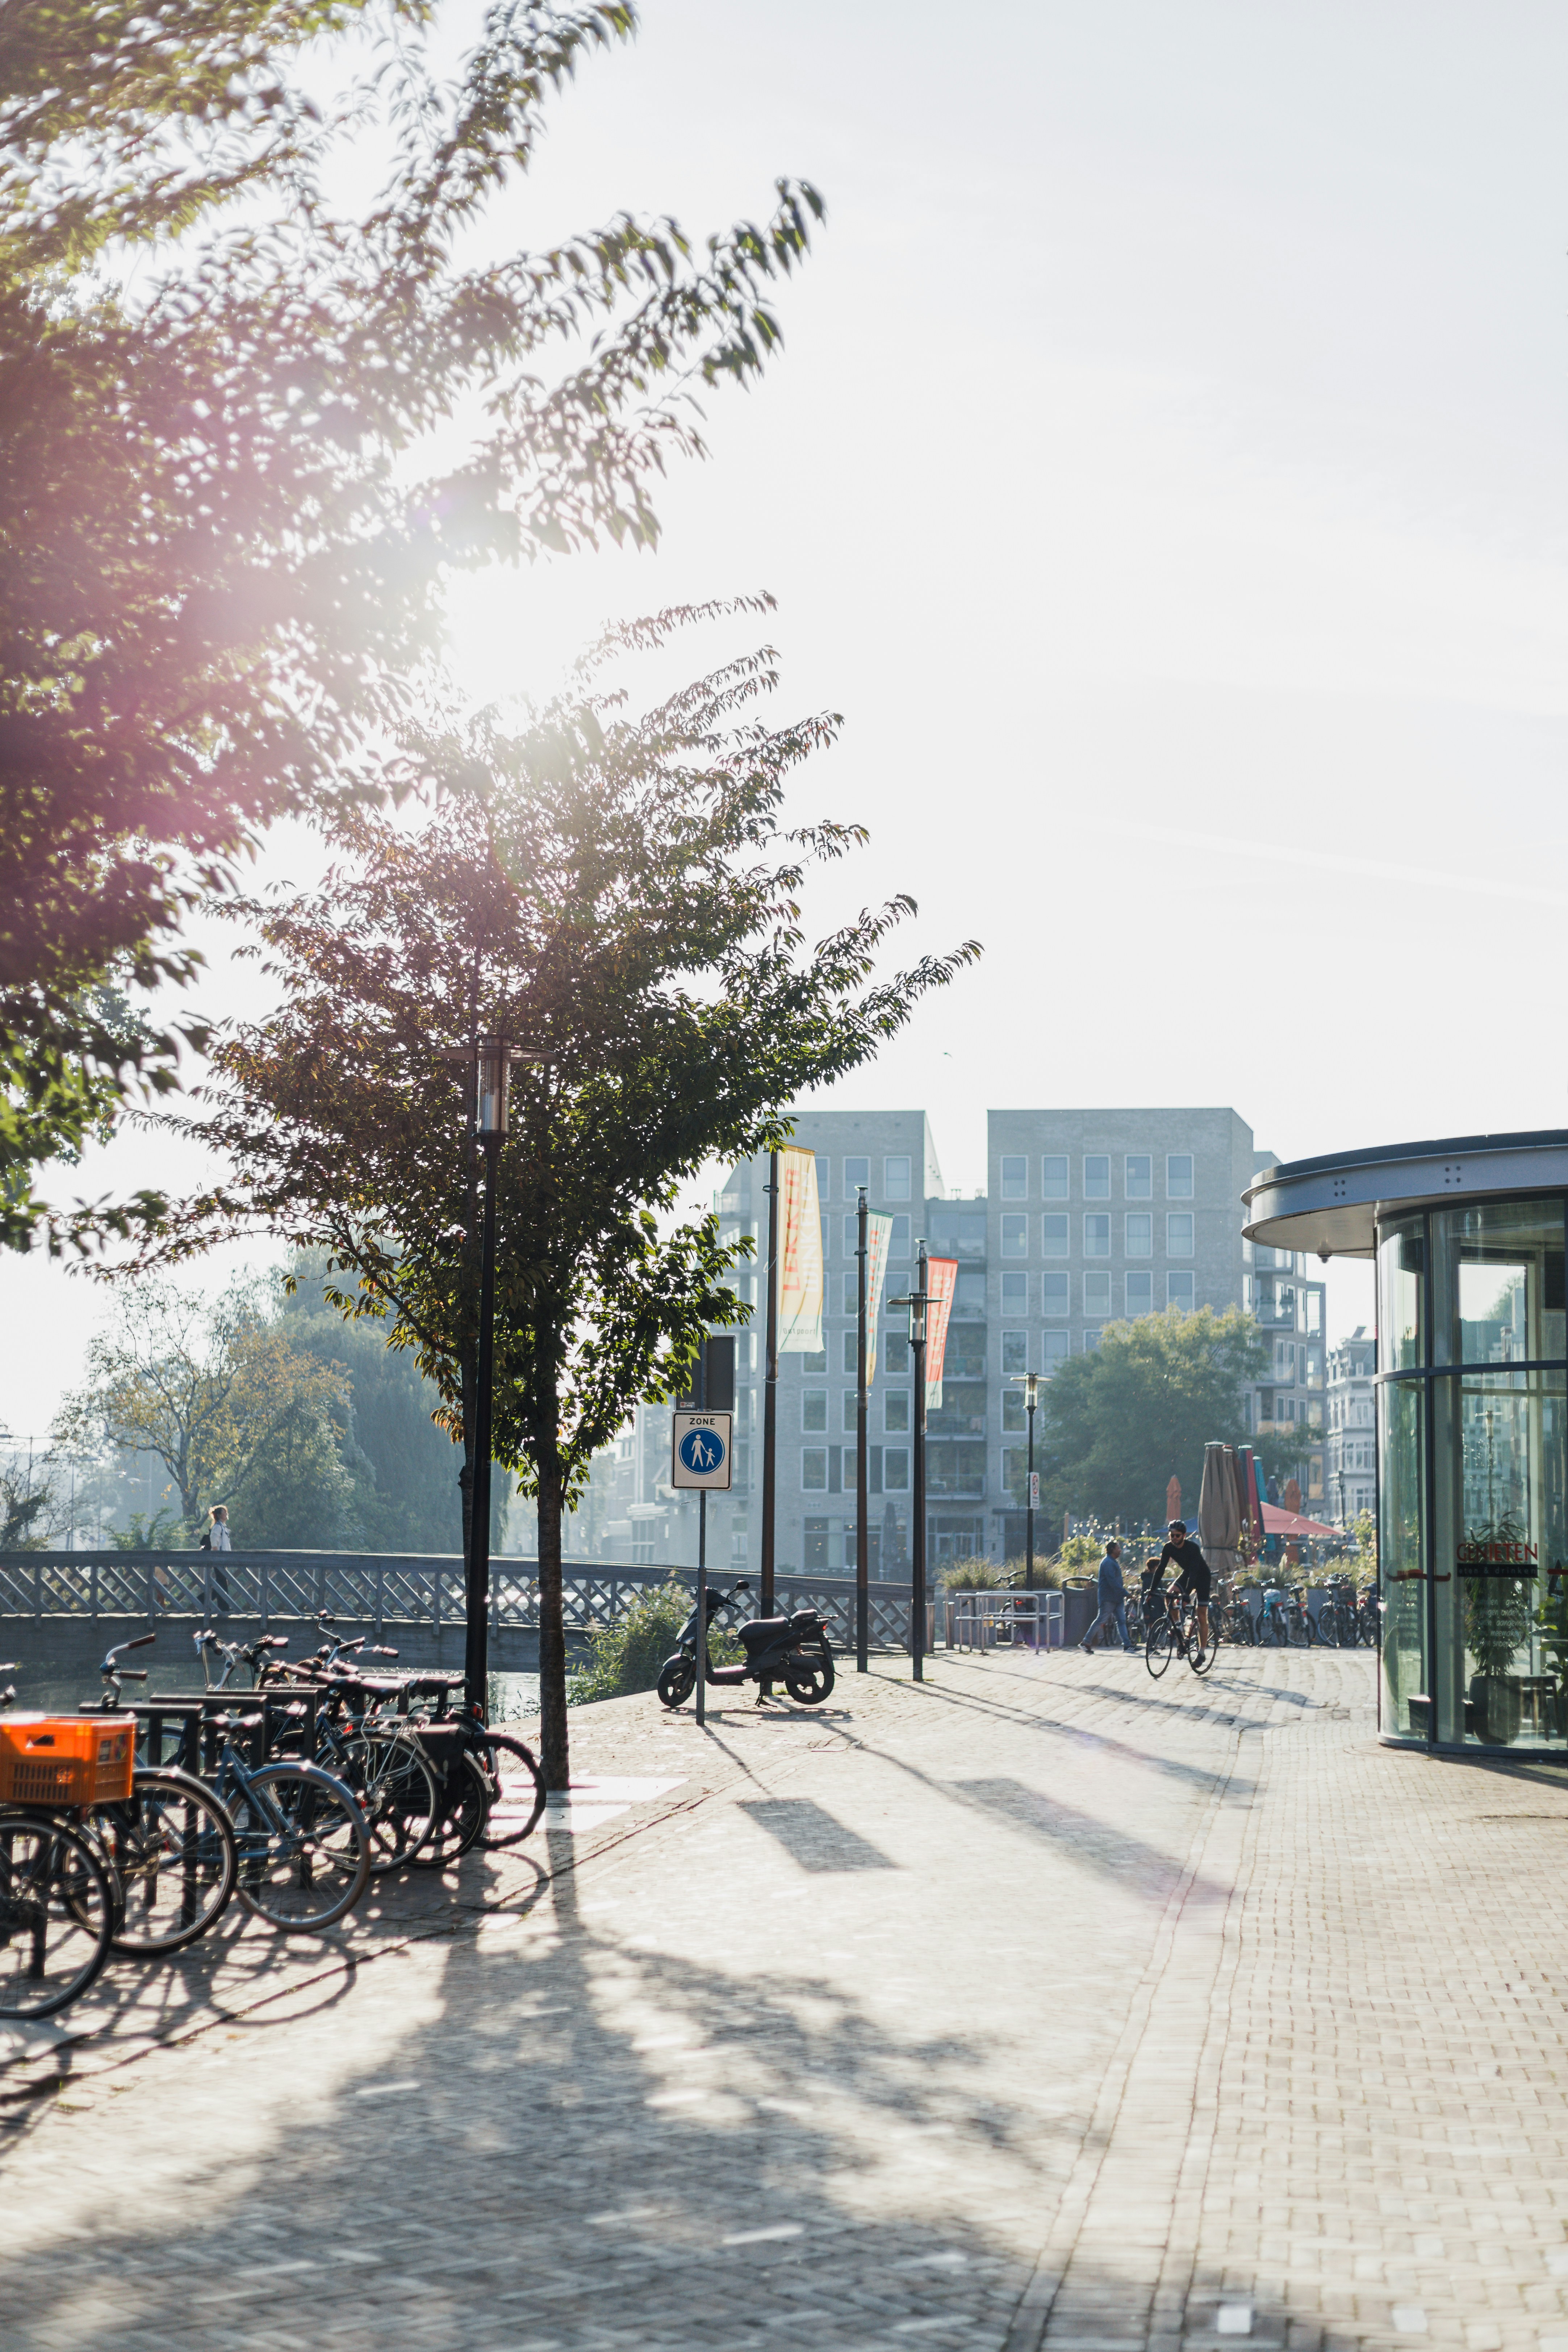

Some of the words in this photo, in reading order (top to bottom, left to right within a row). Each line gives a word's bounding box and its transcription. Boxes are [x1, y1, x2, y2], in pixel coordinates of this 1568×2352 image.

[783, 1168, 800, 1291] LEKKER
[800, 1171, 819, 1292] WINKELEN
[1456, 1543, 1538, 1562] GENIETEN
